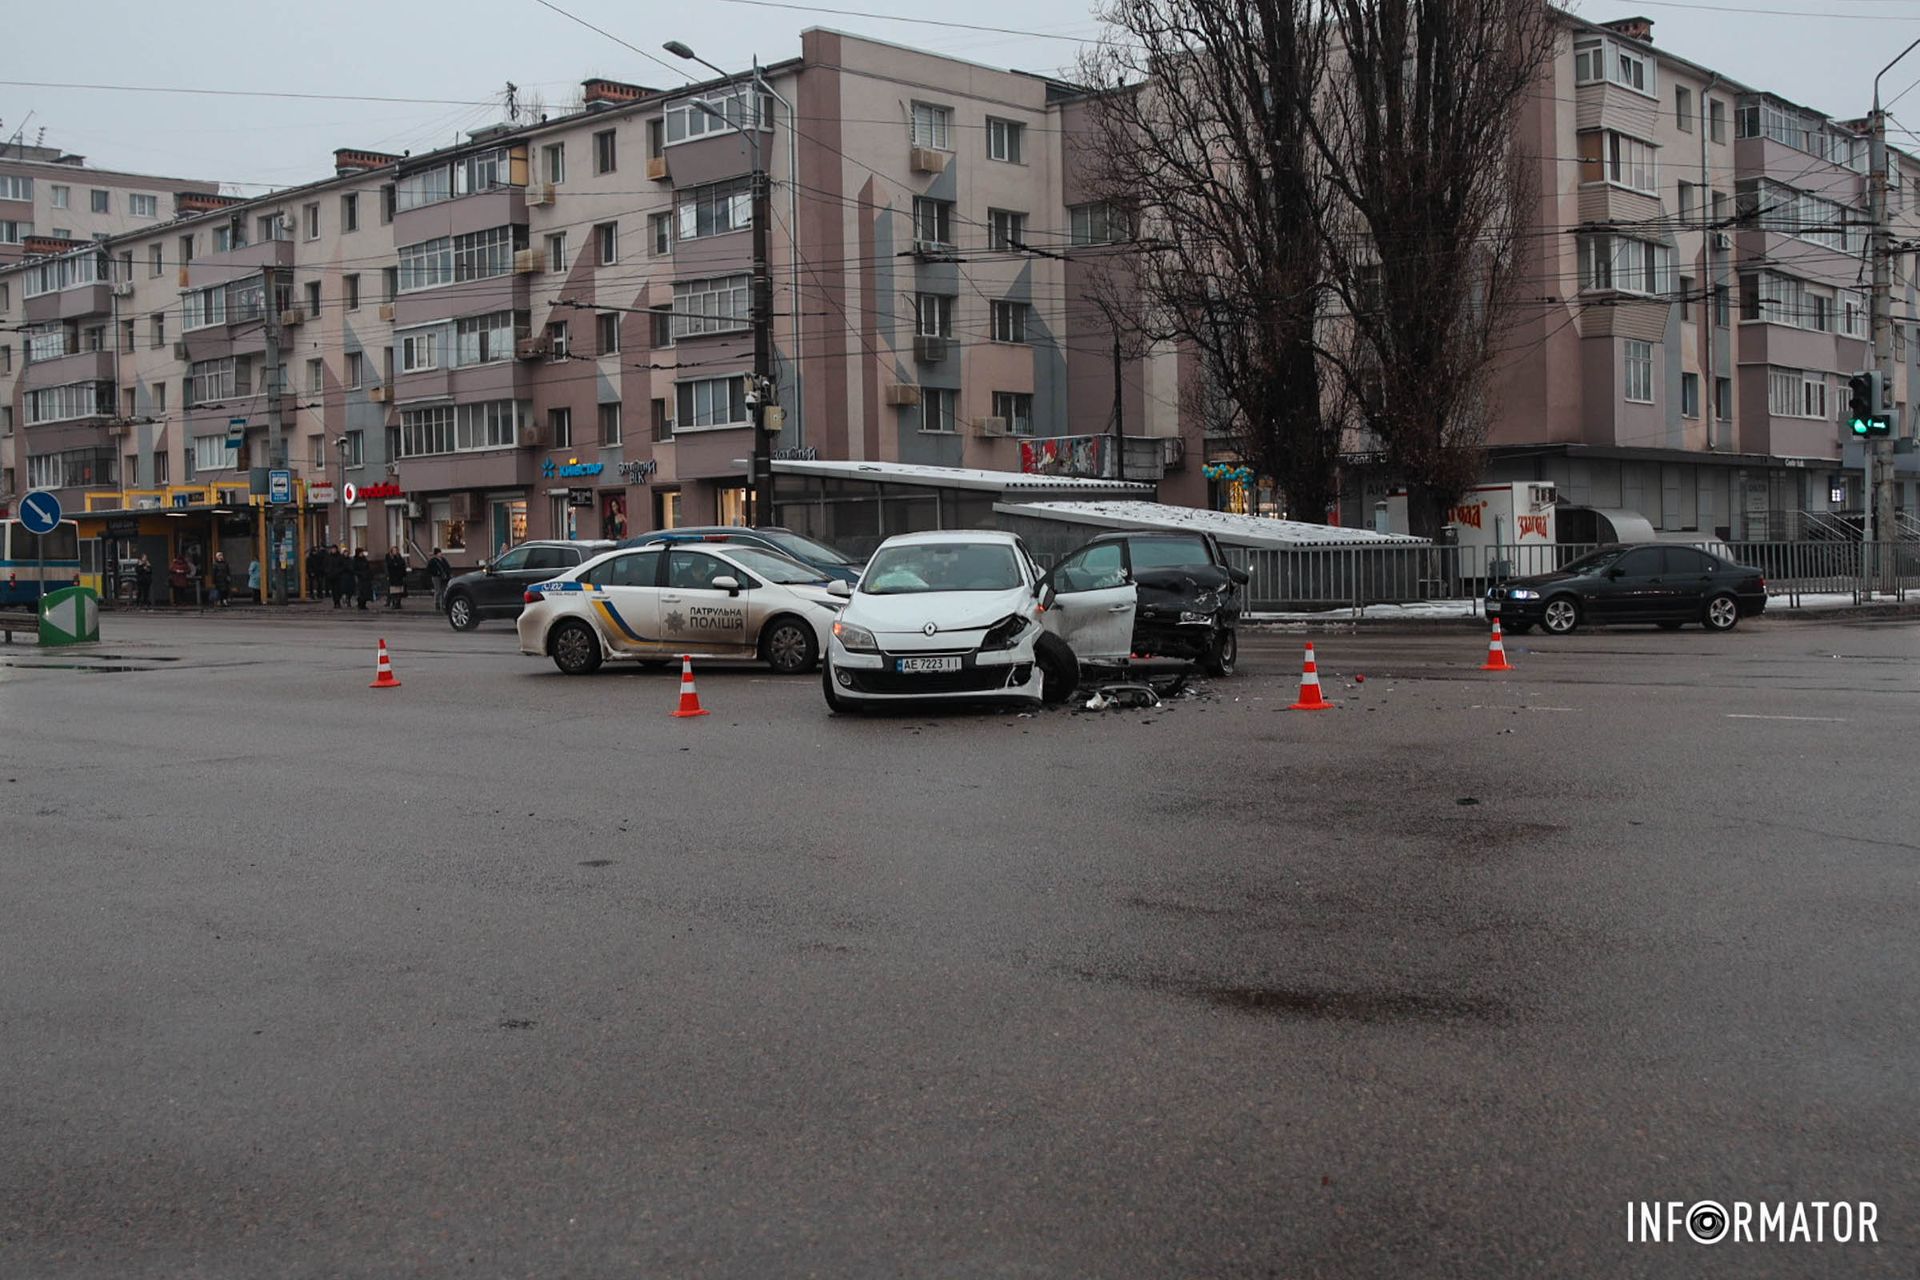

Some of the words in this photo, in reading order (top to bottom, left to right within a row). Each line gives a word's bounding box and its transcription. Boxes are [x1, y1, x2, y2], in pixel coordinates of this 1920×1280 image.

[690, 607, 742, 616] ПАТРУЛЬНА
[690, 617, 744, 629] ПОЛІЦІЯ
[905, 659, 918, 670] AE
[921, 659, 943, 669] 7223
